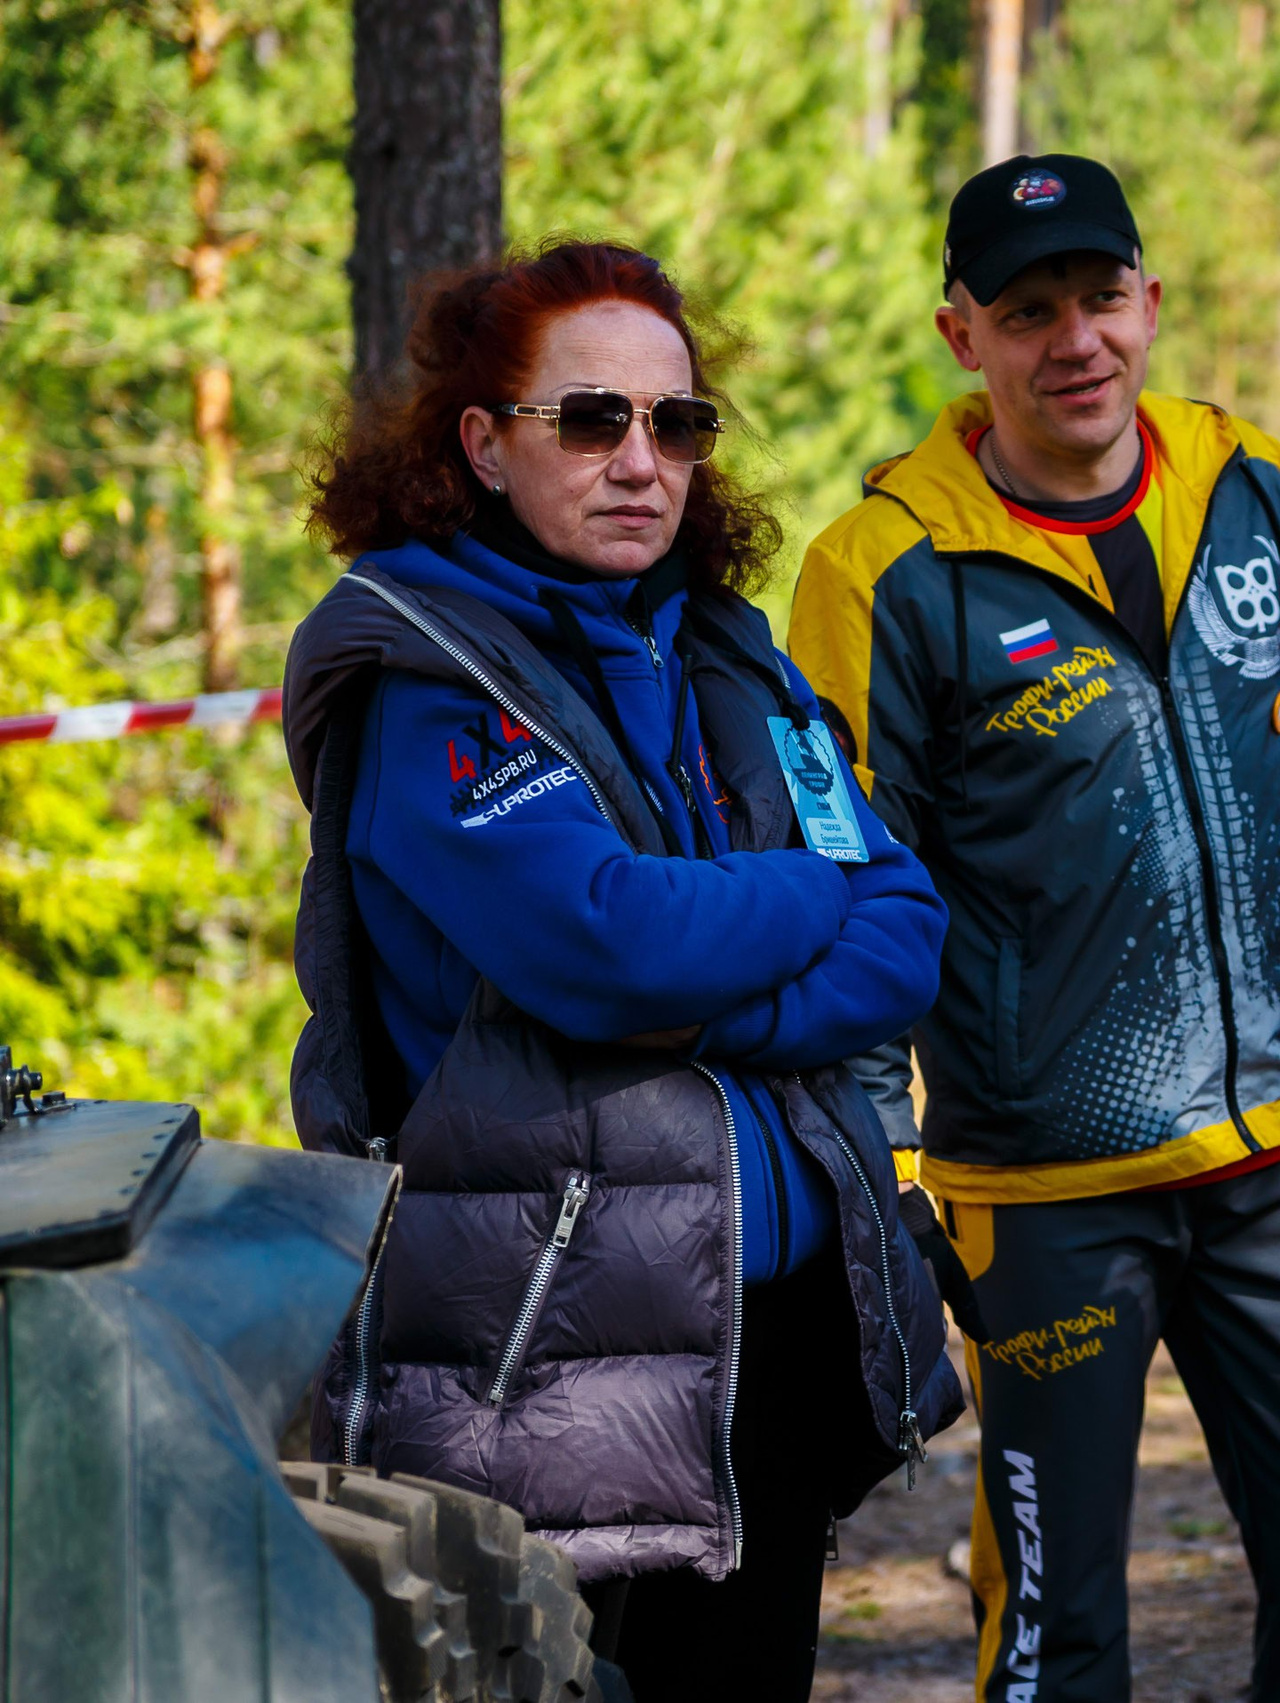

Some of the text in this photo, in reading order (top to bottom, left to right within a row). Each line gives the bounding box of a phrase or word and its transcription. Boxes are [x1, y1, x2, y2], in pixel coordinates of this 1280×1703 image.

[985, 646, 1117, 732] Трофи-рейды
[1025, 677, 1113, 737] России
[472, 749, 538, 800] 4X4SPB.RU
[982, 1305, 1116, 1364] Трофи-рейды
[1016, 1338, 1104, 1380] России
[1003, 1449, 1043, 1703] ACE TEAM
